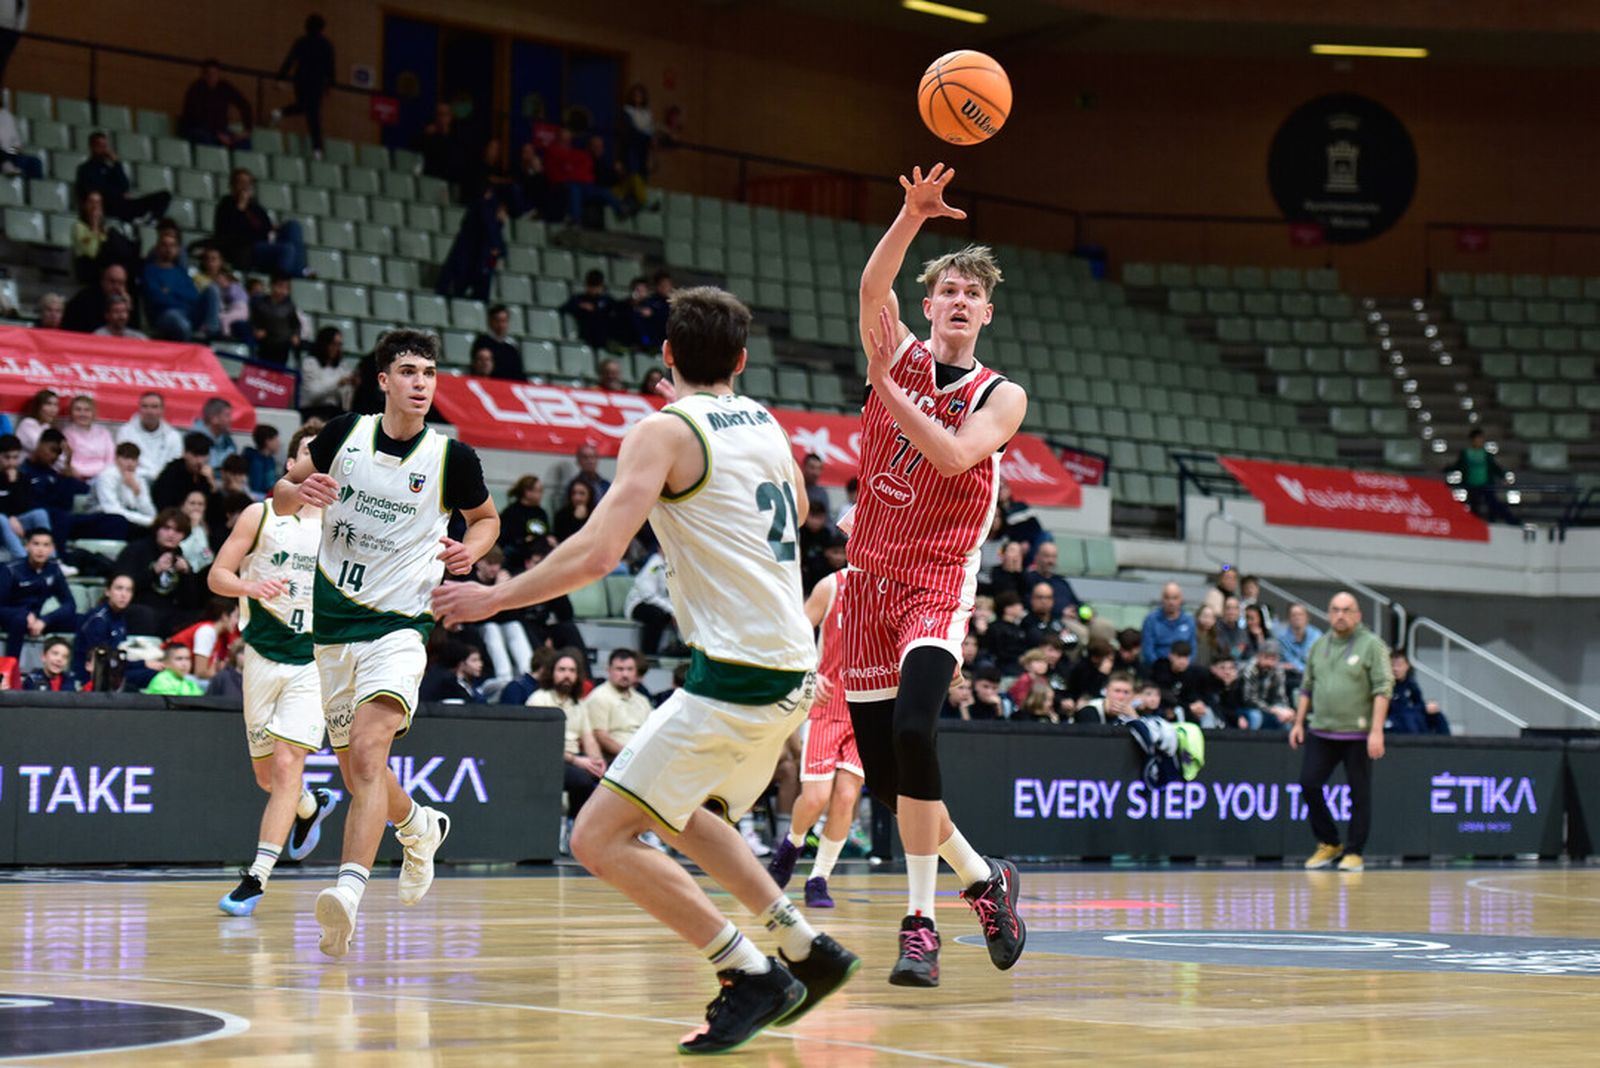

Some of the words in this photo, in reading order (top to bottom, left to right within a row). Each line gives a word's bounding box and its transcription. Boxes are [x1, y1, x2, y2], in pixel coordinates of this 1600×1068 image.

[357, 491, 416, 515] Fundación
[875, 480, 911, 502] Juver
[355, 502, 397, 523] Unicaja
[338, 560, 366, 592] 14
[290, 609, 304, 632] 4
[18, 766, 155, 813] TAKE
[1014, 778, 1121, 819] EVERY
[1212, 782, 1279, 821] YOU
